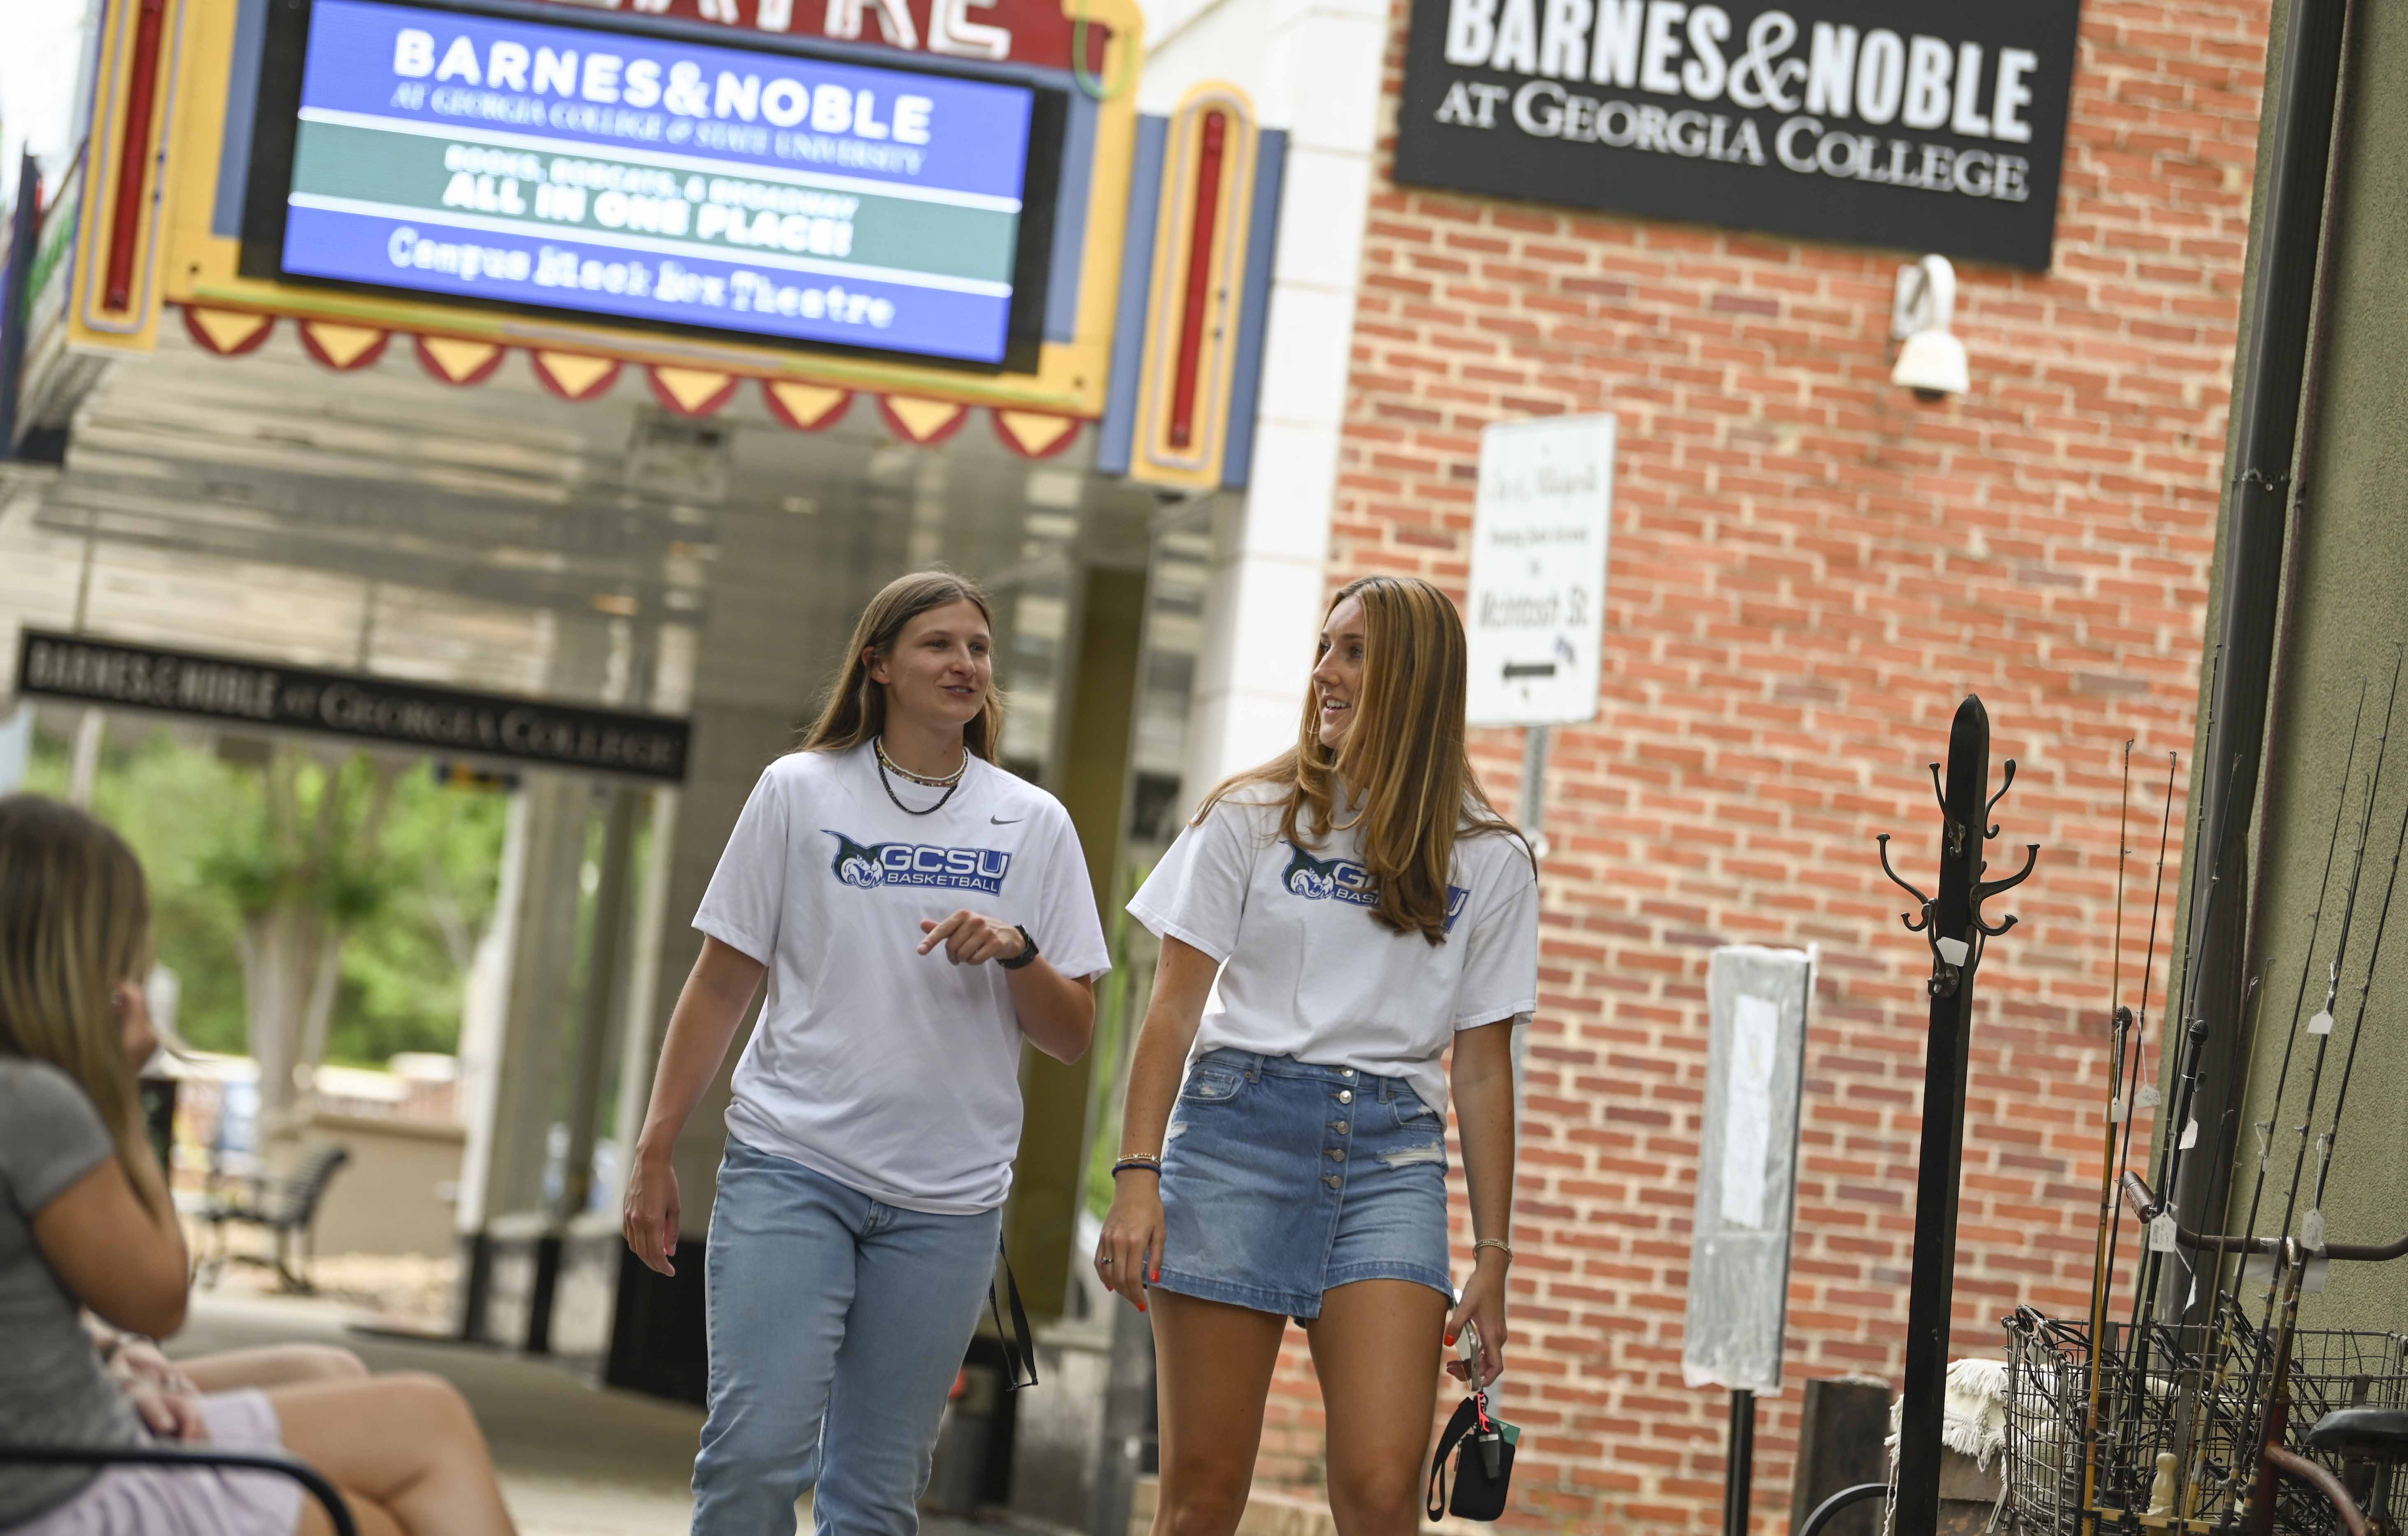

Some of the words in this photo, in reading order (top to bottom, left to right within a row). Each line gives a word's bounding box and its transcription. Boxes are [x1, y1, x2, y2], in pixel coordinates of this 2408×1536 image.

[392, 28, 934, 145] BARNES&NOBLE
[549, 101, 665, 142] COLLEGE
[694, 120, 772, 156] STATE
[774, 132, 927, 176] UNIVERSITY
[1434, 81, 1510, 129] AT
[1512, 80, 1767, 166] GEORGIA
[1775, 116, 2030, 202] COLLEGE
[443, 172, 526, 214] ALL
[535, 184, 587, 223] IN
[593, 189, 690, 235] ONE
[880, 845, 1009, 879] GCSU
[887, 873, 999, 893] BASKETBALL
